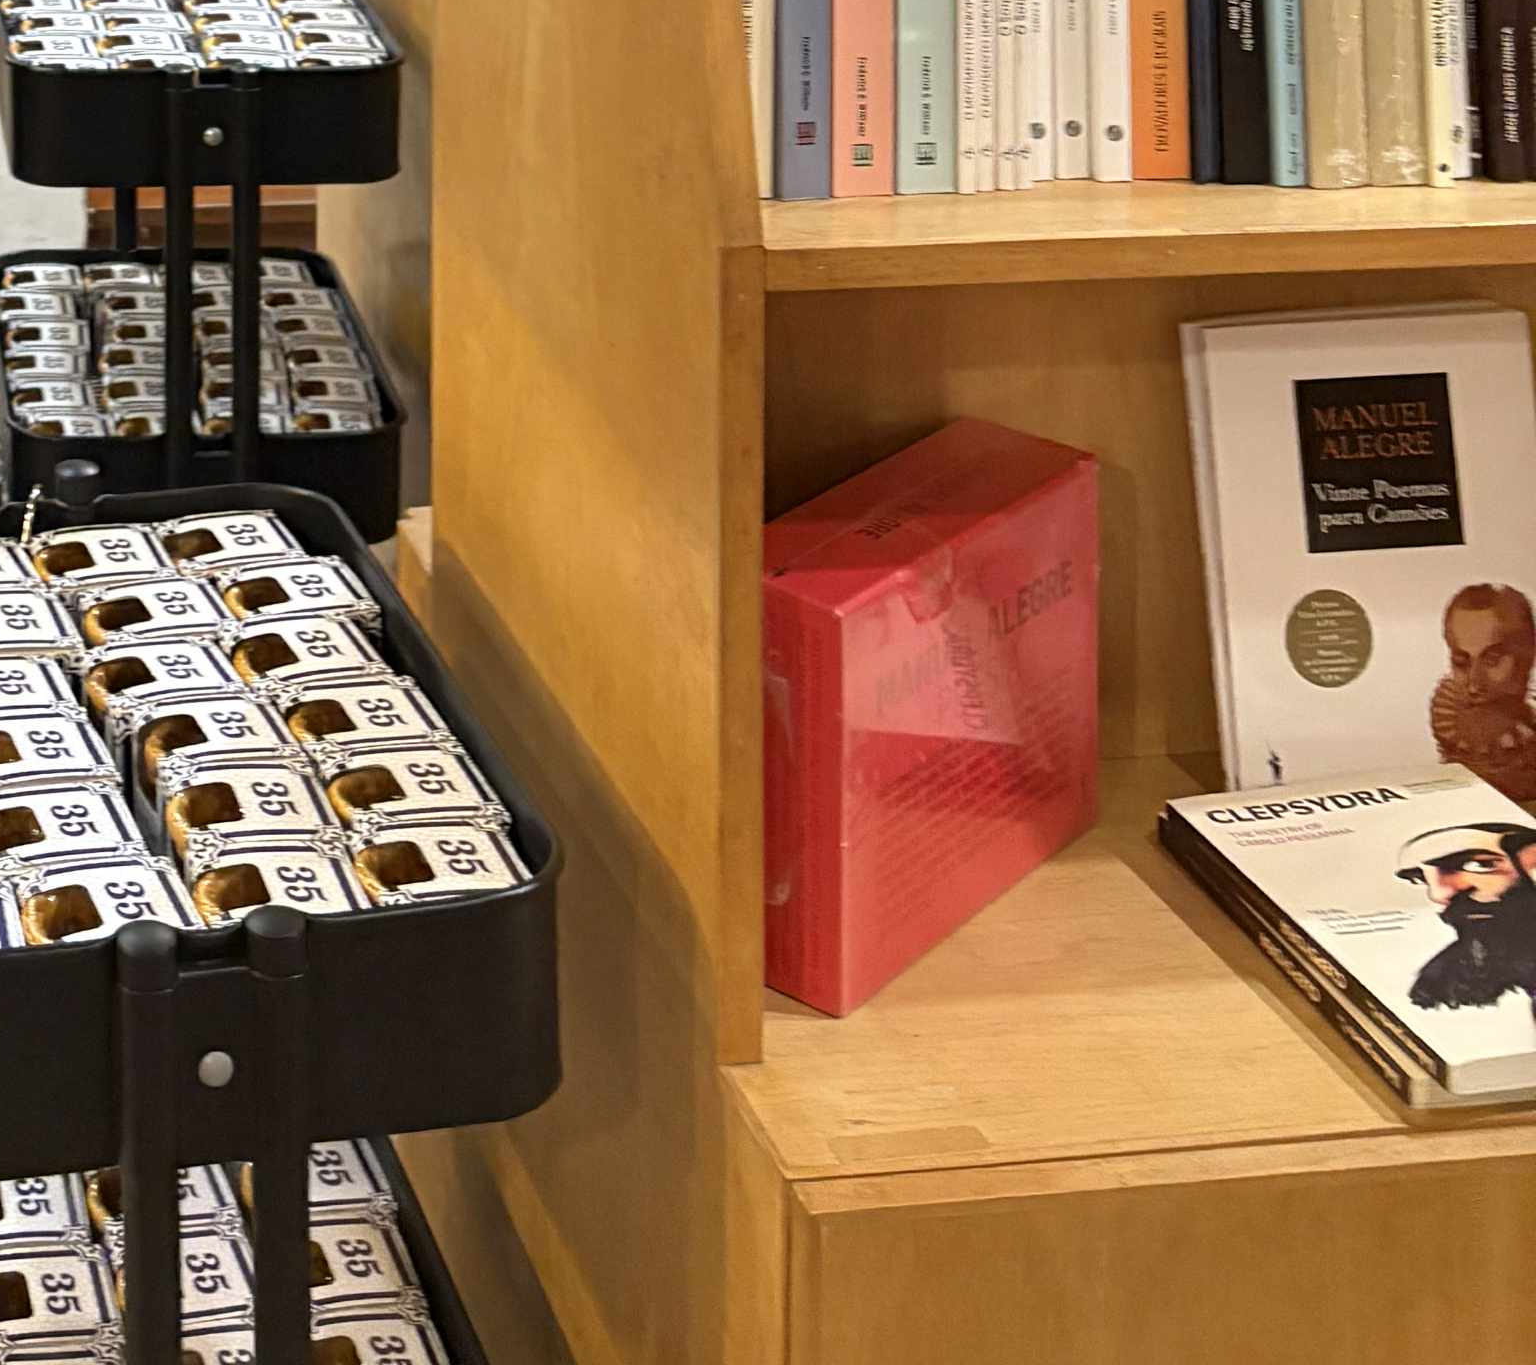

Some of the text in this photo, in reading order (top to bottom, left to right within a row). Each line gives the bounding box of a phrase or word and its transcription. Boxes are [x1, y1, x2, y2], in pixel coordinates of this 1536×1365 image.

[1000, 26, 1012, 37] O
[1152, 10, 1168, 60] JOGRAIS
[1153, 73, 1169, 152] TROVADORES
[1311, 401, 1438, 432] MANUEL
[1320, 431, 1435, 460] ALEGRE
[1373, 479, 1450, 499] Poemas
[225, 524, 259, 546] 35
[1318, 511, 1365, 534] para
[100, 539, 133, 562] 35
[291, 575, 323, 597] 35
[987, 561, 1075, 640] ALEGRE
[0, 605, 33, 630] 35
[155, 592, 190, 615] 35
[297, 630, 331, 657] 35
[157, 655, 193, 679] 35
[210, 712, 253, 738] 35
[358, 699, 405, 727] 35
[28, 731, 70, 759] 35
[408, 763, 458, 794] 35
[251, 782, 300, 816] 35
[1206, 787, 1409, 825] CLEPSYDRA
[51, 805, 93, 836] 35
[437, 840, 490, 874] 35
[277, 867, 327, 902] 35
[105, 882, 157, 919] 35
[312, 1146, 353, 1187] 35
[17, 1177, 52, 1217] 35
[186, 1253, 230, 1294] 35
[337, 1239, 384, 1277] 35
[41, 1274, 82, 1315] 35
